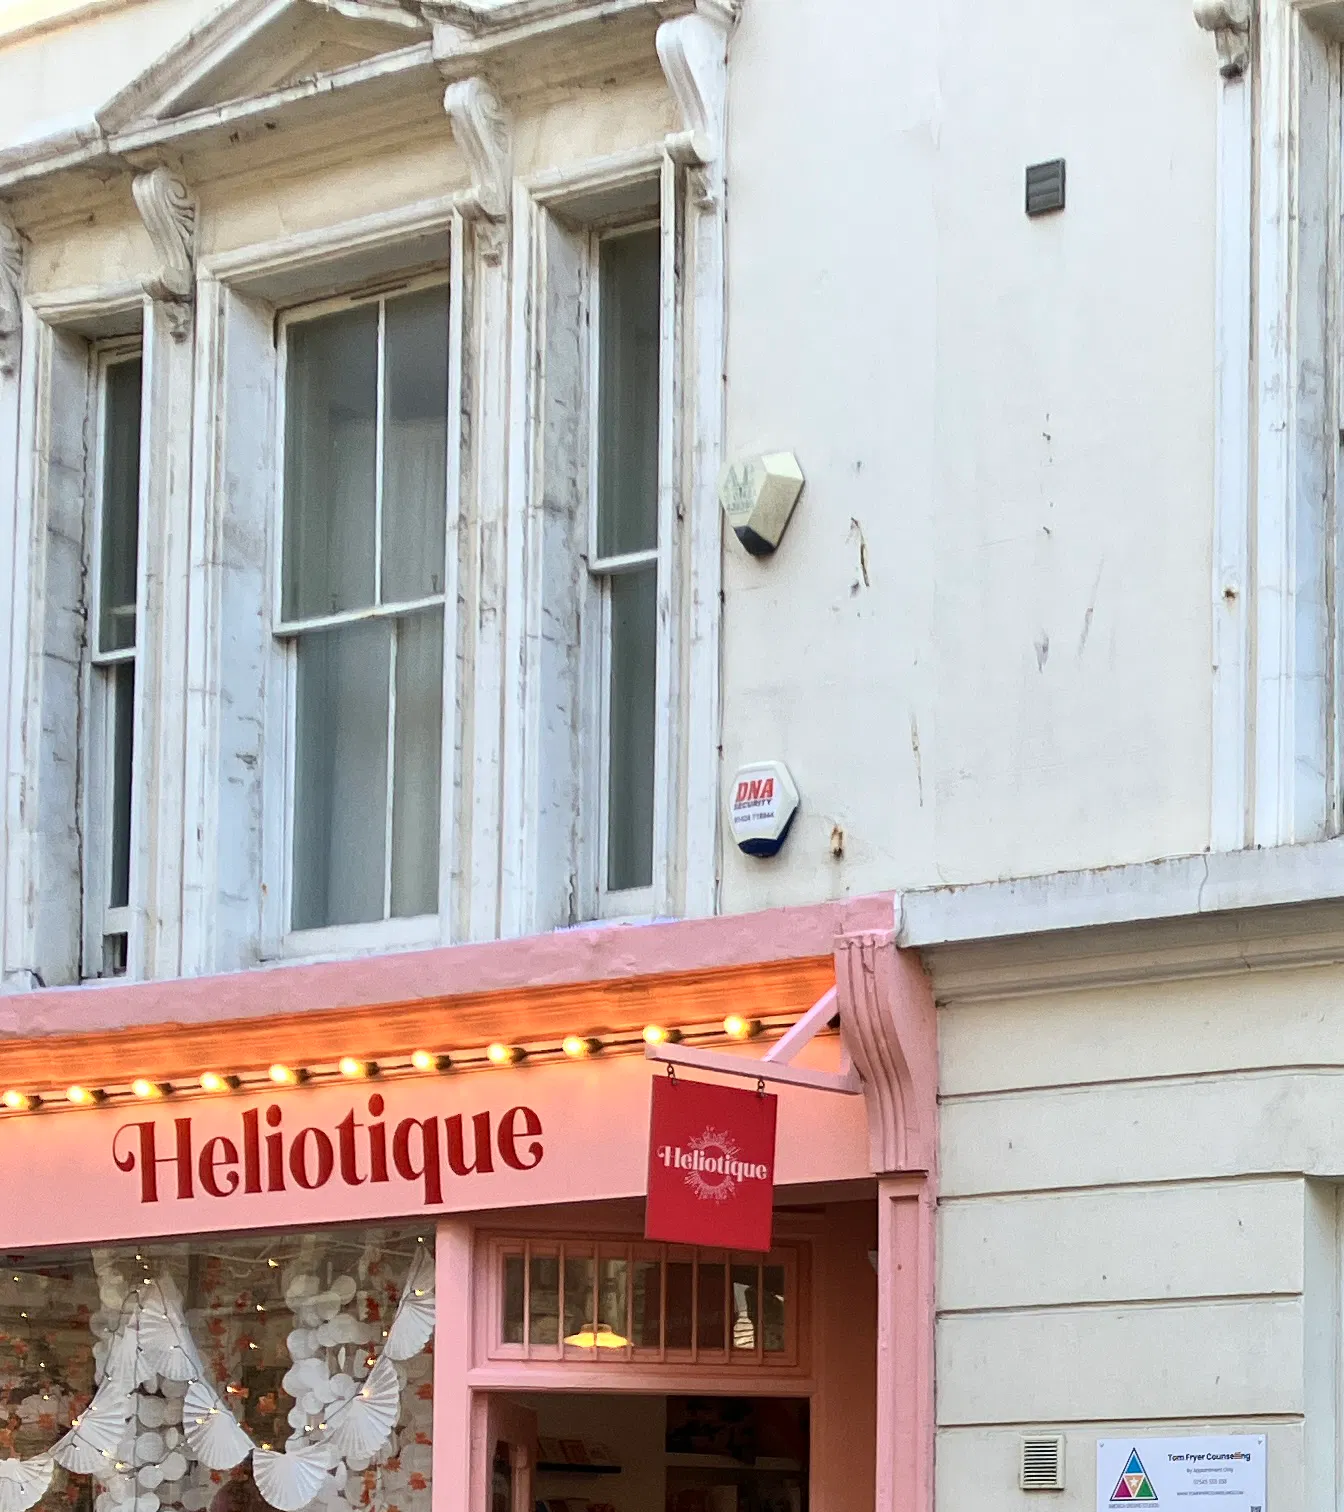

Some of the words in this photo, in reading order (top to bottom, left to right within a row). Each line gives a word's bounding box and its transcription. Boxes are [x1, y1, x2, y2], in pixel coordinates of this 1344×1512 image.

[735, 778, 774, 802] DNA
[734, 799, 772, 811] SECURITY
[113, 1093, 543, 1205] Heliotique
[657, 1145, 767, 1182] Heliotique
[1186, 1453, 1205, 1463] Fryer
